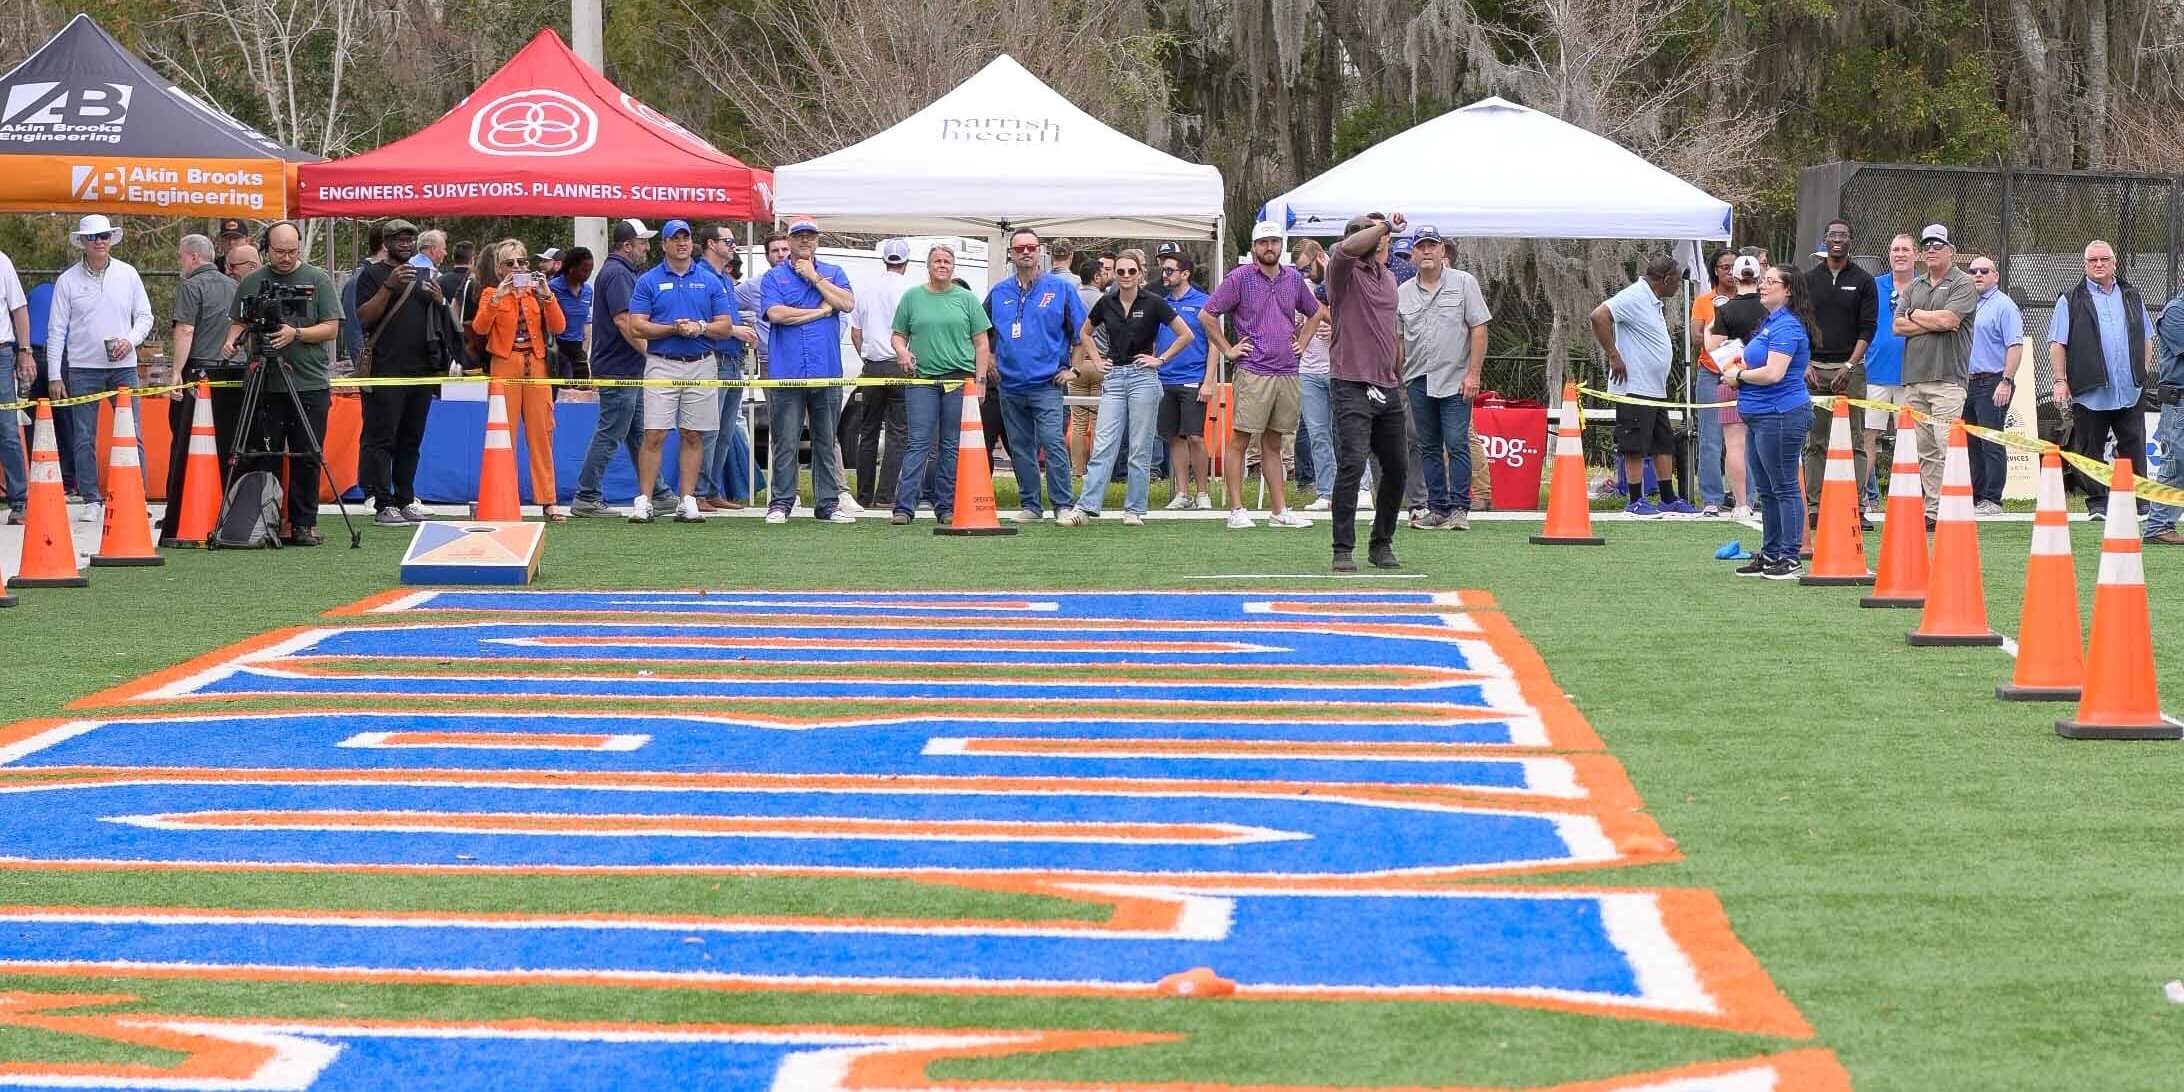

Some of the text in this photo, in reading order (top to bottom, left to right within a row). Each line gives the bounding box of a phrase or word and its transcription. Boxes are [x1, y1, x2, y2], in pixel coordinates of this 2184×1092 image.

[0, 124, 122, 132] Akin Brooks
[943, 118, 1060, 135] parrish
[0, 132, 121, 143] Engineering
[129, 167, 264, 186] Akin Brooks
[128, 186, 264, 209] Engineering
[319, 185, 419, 200] ENGINEERS.
[423, 182, 528, 198] SURVEYORS.
[532, 183, 627, 199] PLANNERS.
[631, 186, 731, 202] SCIENTISTS.
[1038, 292, 1056, 308] F
